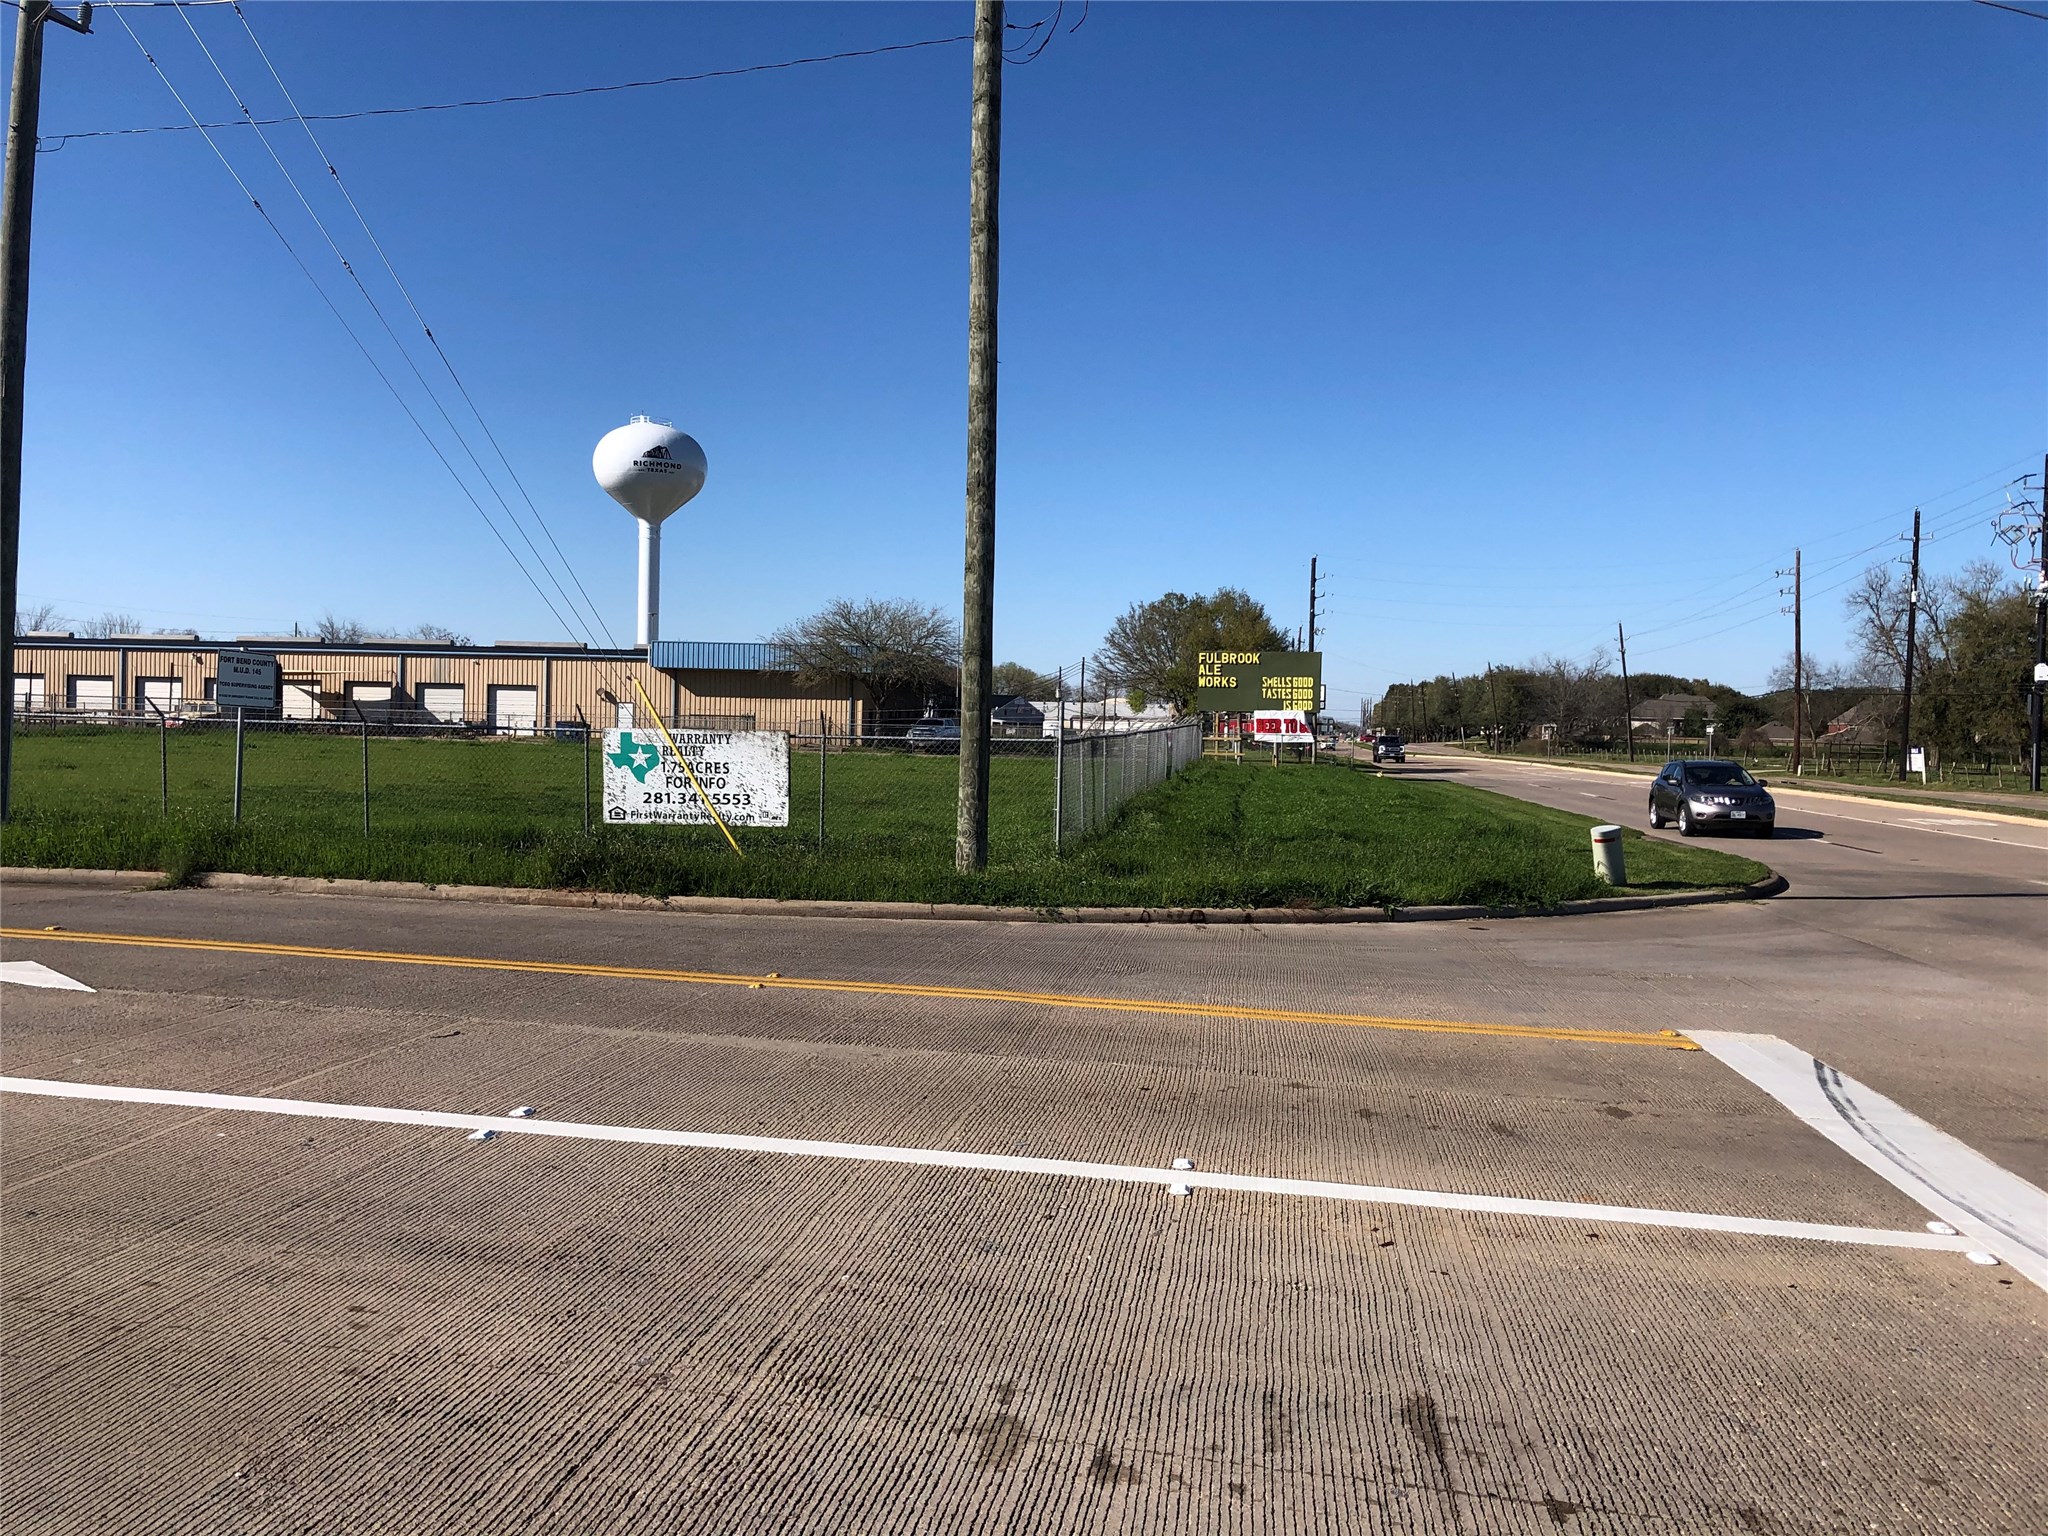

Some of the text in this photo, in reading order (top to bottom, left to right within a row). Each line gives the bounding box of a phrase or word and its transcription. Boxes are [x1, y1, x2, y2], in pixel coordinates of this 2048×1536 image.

[633, 460, 682, 470] RICHMOND
[236, 657, 251, 665] BEND
[252, 659, 274, 667] COUNTY
[1199, 653, 1260, 664] FULBROOK
[252, 668, 262, 676] 145
[1199, 664, 1222, 676] ALE
[1198, 676, 1237, 688] WORKS
[1262, 677, 1314, 688] SMELLS GOOD
[1262, 688, 1313, 700] TASTES GOOD
[1283, 700, 1313, 711] IS GOOD
[668, 733, 732, 744] WARRANTY
[688, 762, 730, 774] ACRES
[666, 776, 693, 788] FOR
[643, 792, 751, 805] 281.3415553
[630, 810, 755, 822] FirstWarrantyRelty.com
